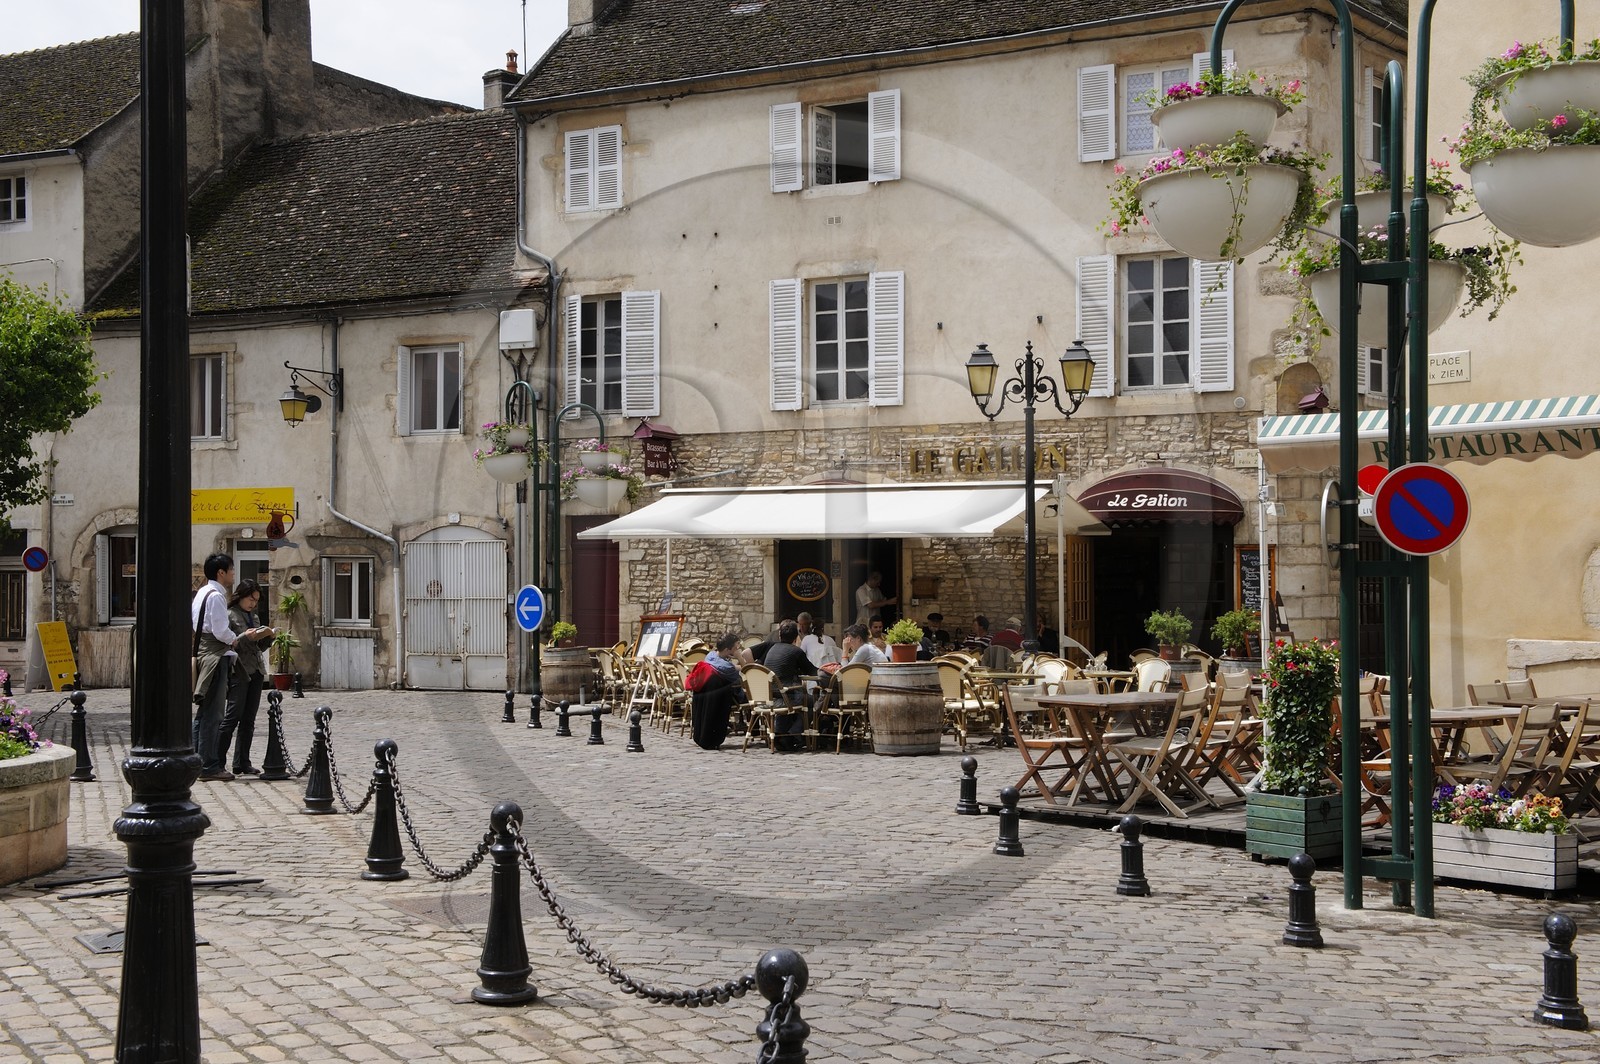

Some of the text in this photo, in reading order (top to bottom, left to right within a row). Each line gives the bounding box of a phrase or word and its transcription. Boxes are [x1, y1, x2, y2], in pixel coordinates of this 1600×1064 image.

[1429, 356, 1461, 367] PLACE
[1440, 369, 1464, 379] ZIEM
[646, 442, 667, 452] Brasserie
[1371, 427, 1600, 463] RSTAURANT
[908, 448, 942, 475] LE
[224, 494, 243, 511] de
[1107, 493, 1188, 508] Le Galion
